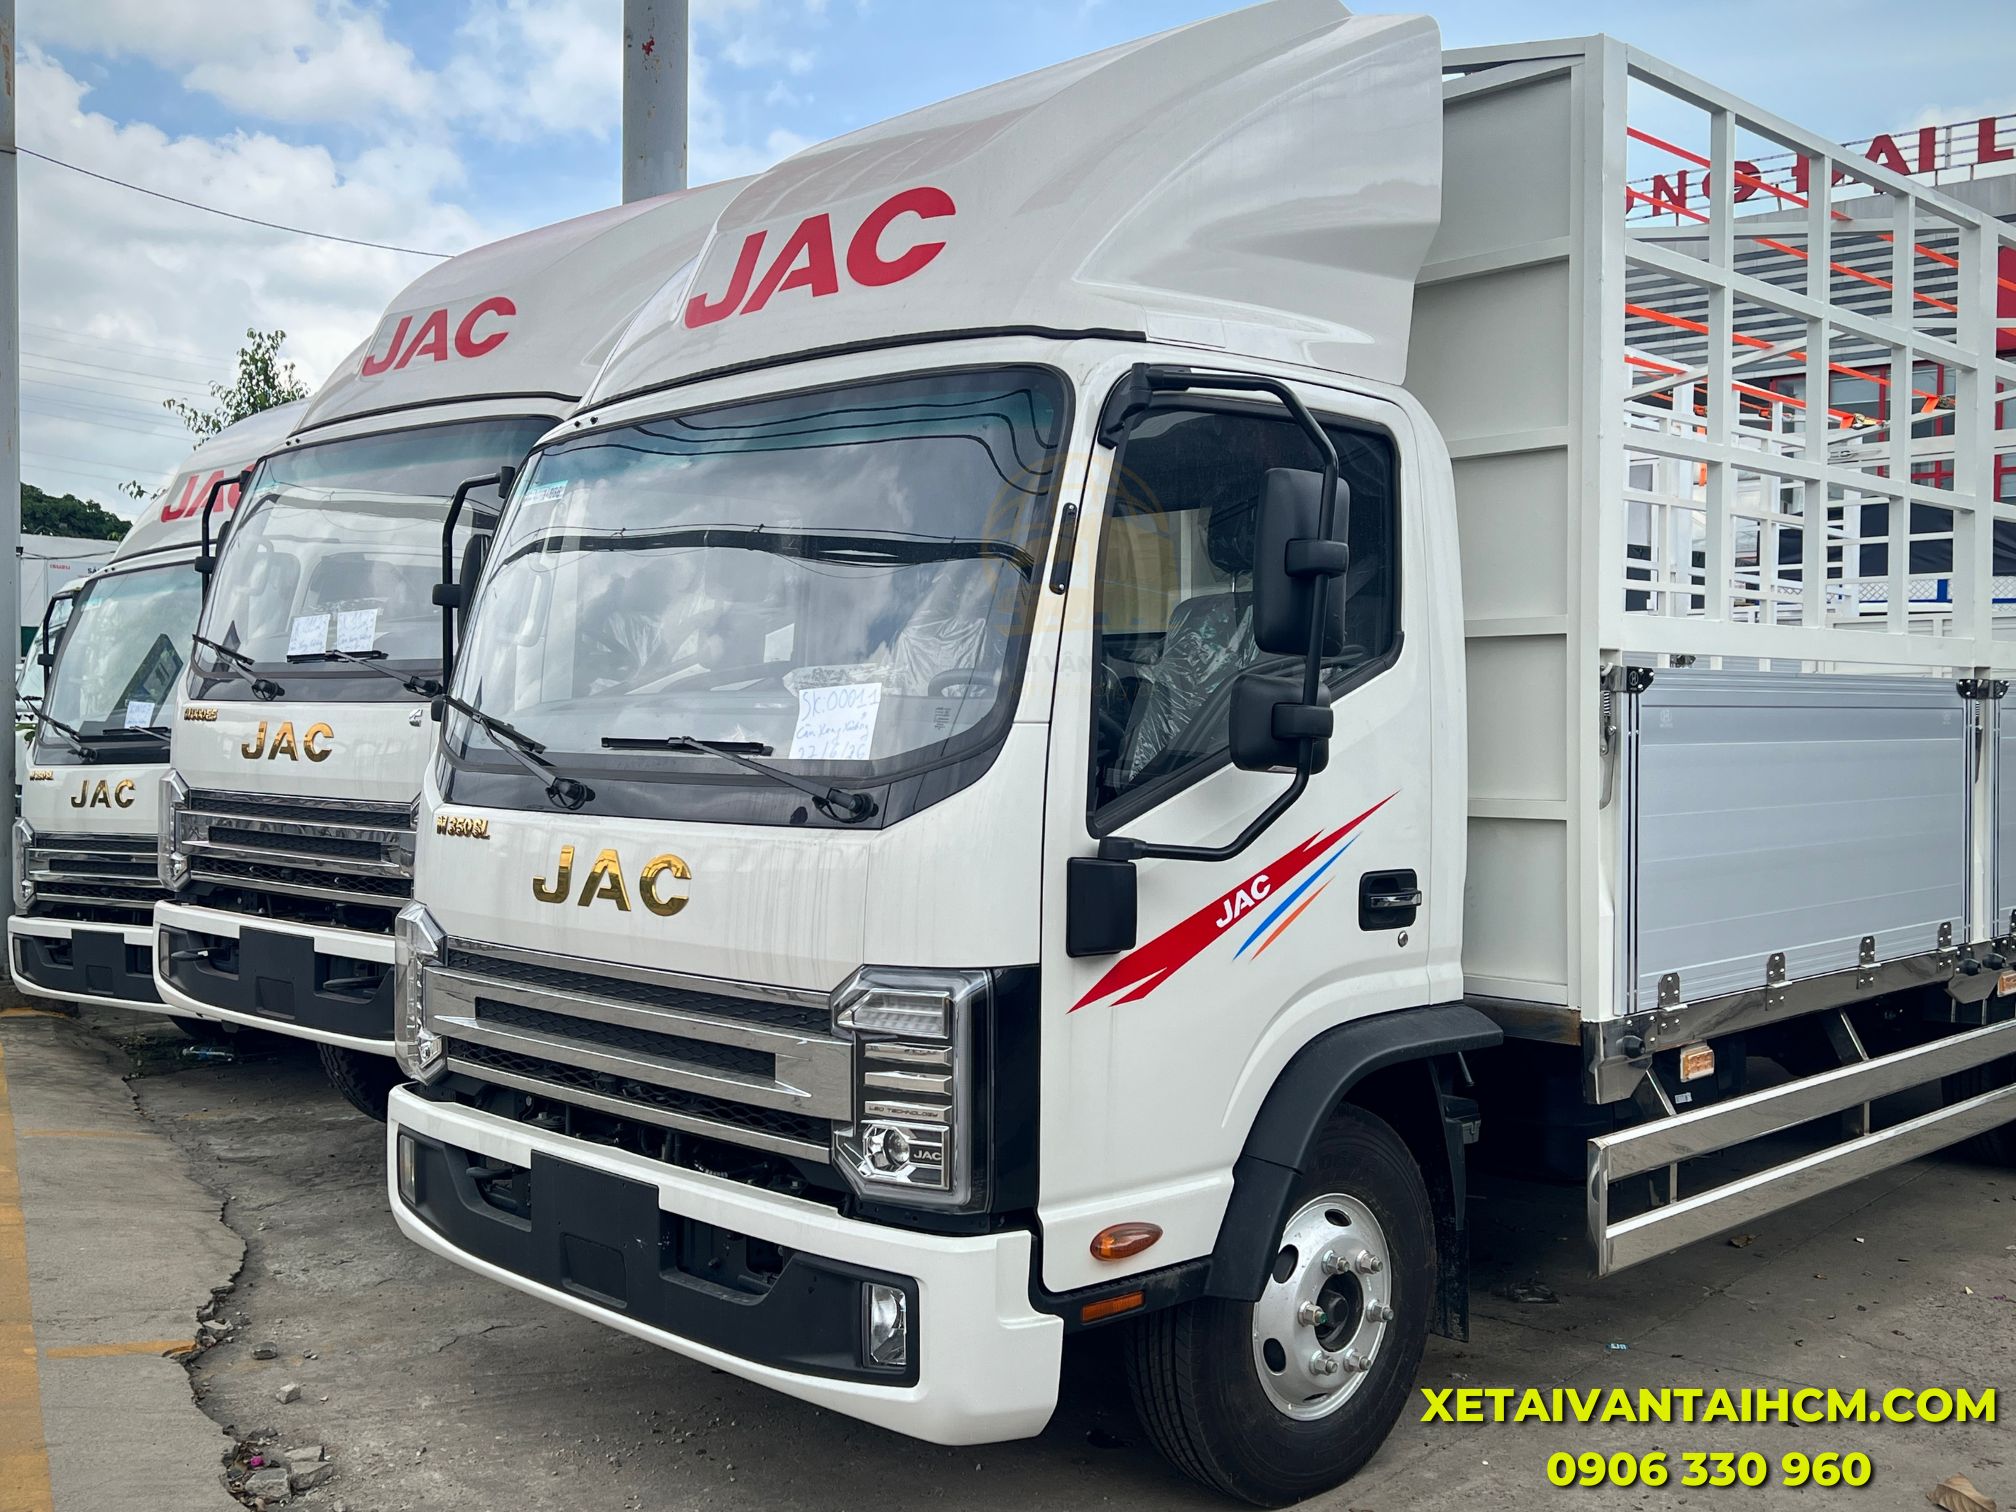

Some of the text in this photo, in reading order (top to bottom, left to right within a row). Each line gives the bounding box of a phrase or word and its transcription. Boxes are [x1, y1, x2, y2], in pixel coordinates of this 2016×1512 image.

[1626, 161, 1762, 216] NG
[684, 186, 956, 329] JAC
[361, 296, 517, 377] JAC
[241, 720, 334, 763] JAC
[70, 779, 136, 808] JAC
[532, 844, 693, 917] JAC
[1215, 874, 1271, 928] JAC
[913, 1149, 942, 1161] JAC
